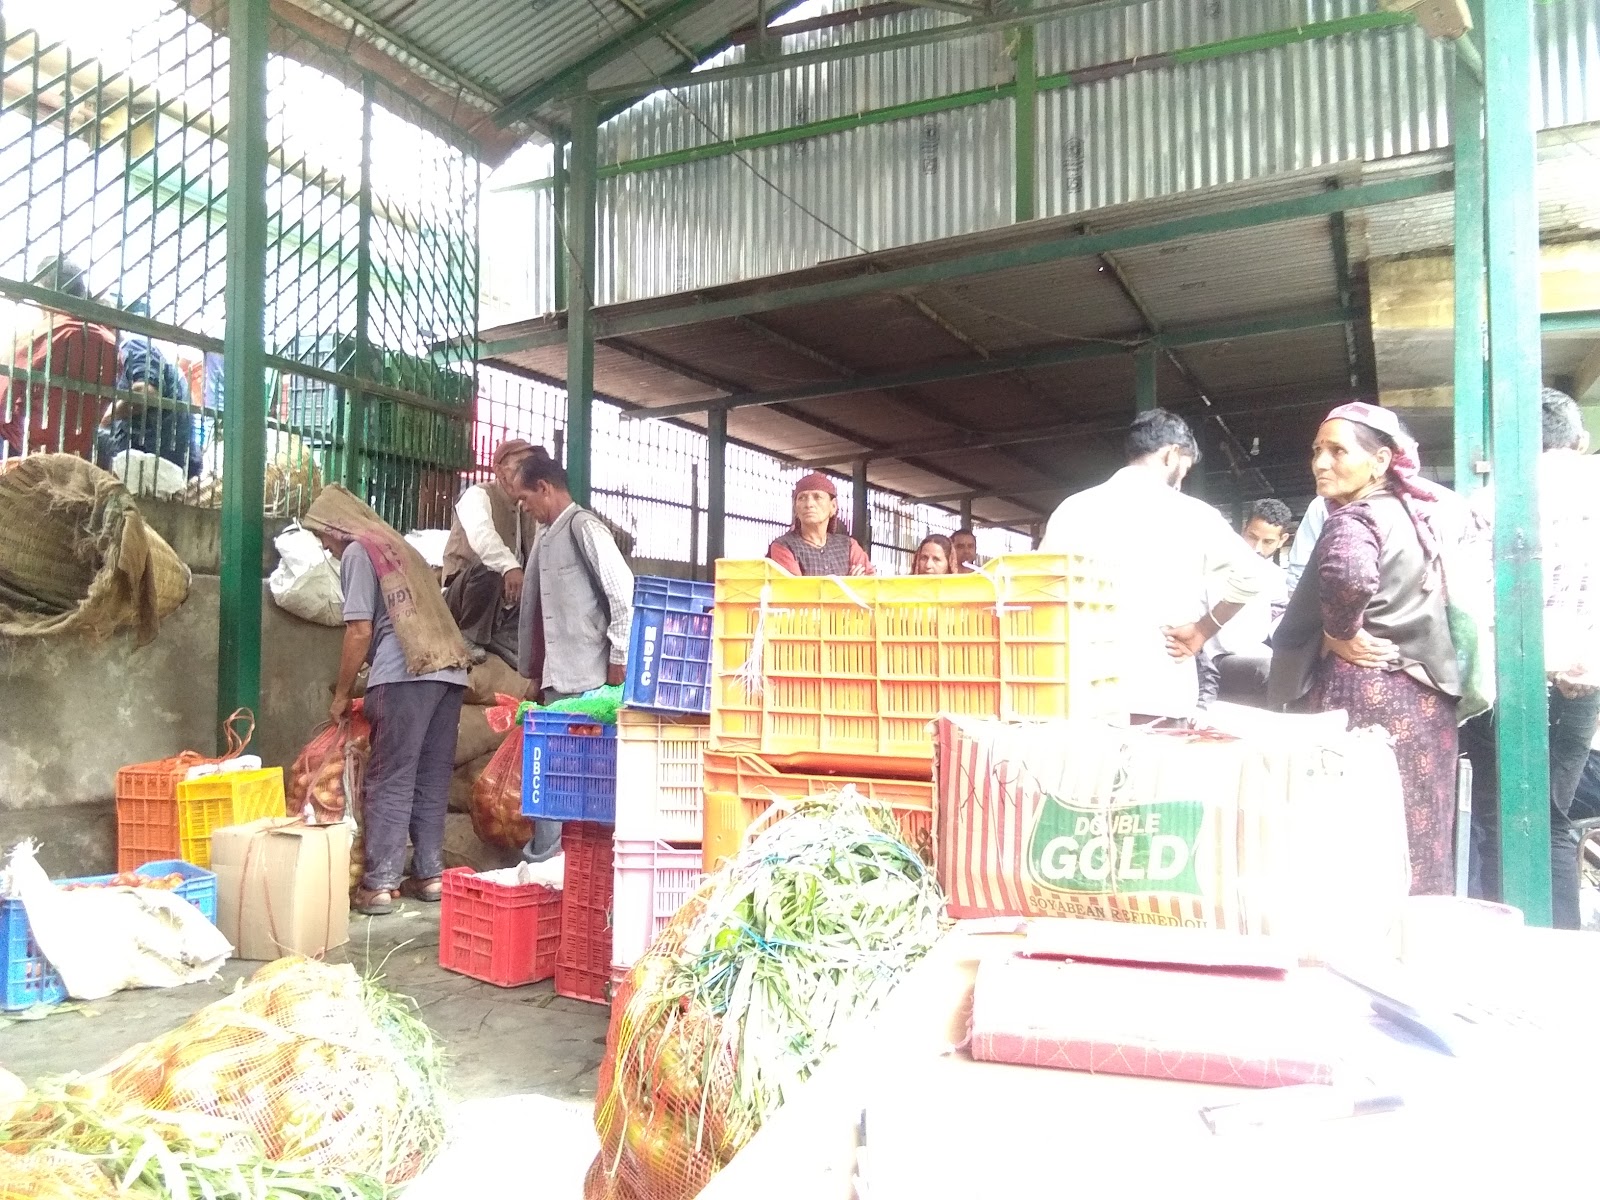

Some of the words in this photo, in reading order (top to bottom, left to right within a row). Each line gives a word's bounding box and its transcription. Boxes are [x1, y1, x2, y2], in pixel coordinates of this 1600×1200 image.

[532, 746, 542, 804] DBCC
[1040, 834, 1189, 880] GOLD
[1029, 895, 1105, 919] SOYABEAN
[1111, 908, 1179, 928] REFINED
